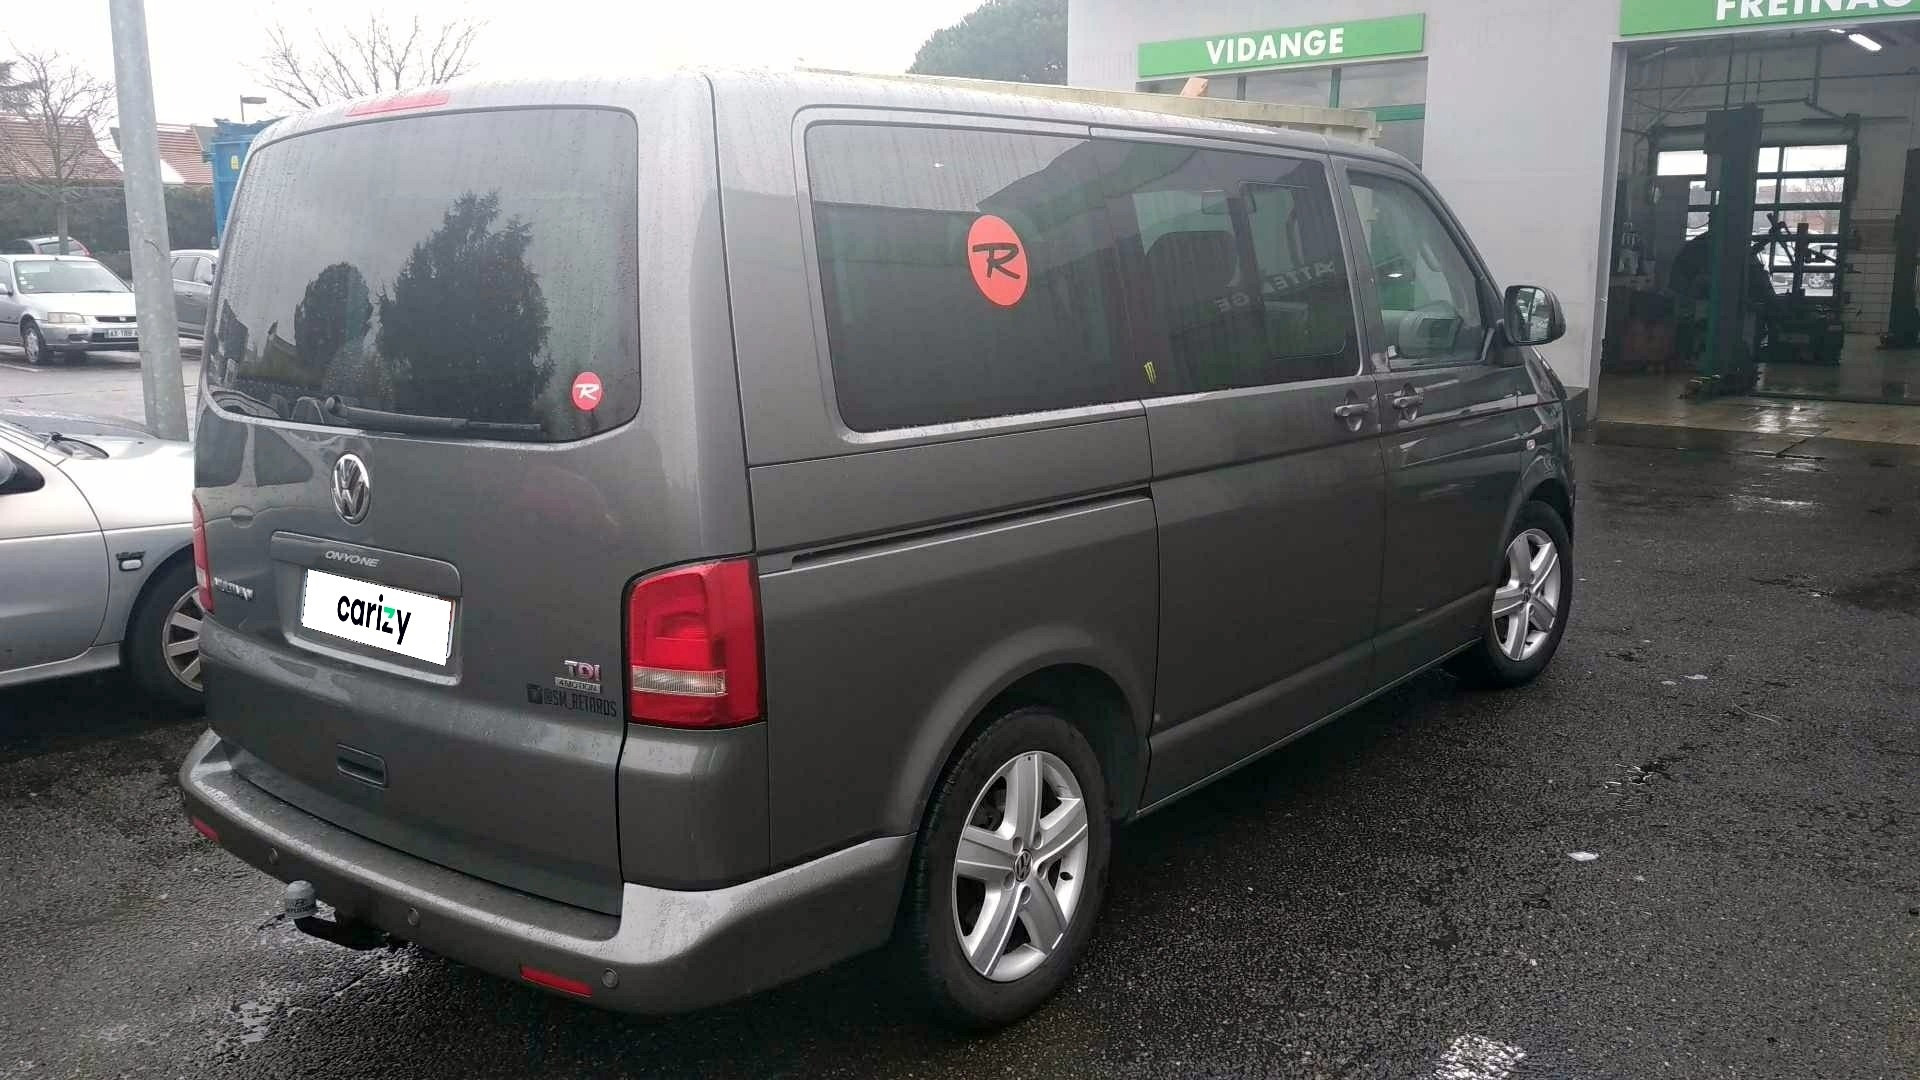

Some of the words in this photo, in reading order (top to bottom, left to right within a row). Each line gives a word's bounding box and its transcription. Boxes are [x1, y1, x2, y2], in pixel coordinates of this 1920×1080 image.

[1716, 0, 1912, 21] FREIN
[1206, 27, 1345, 65] VIDANGE
[325, 550, 380, 569] ONYONE
[563, 659, 601, 682] TDI
